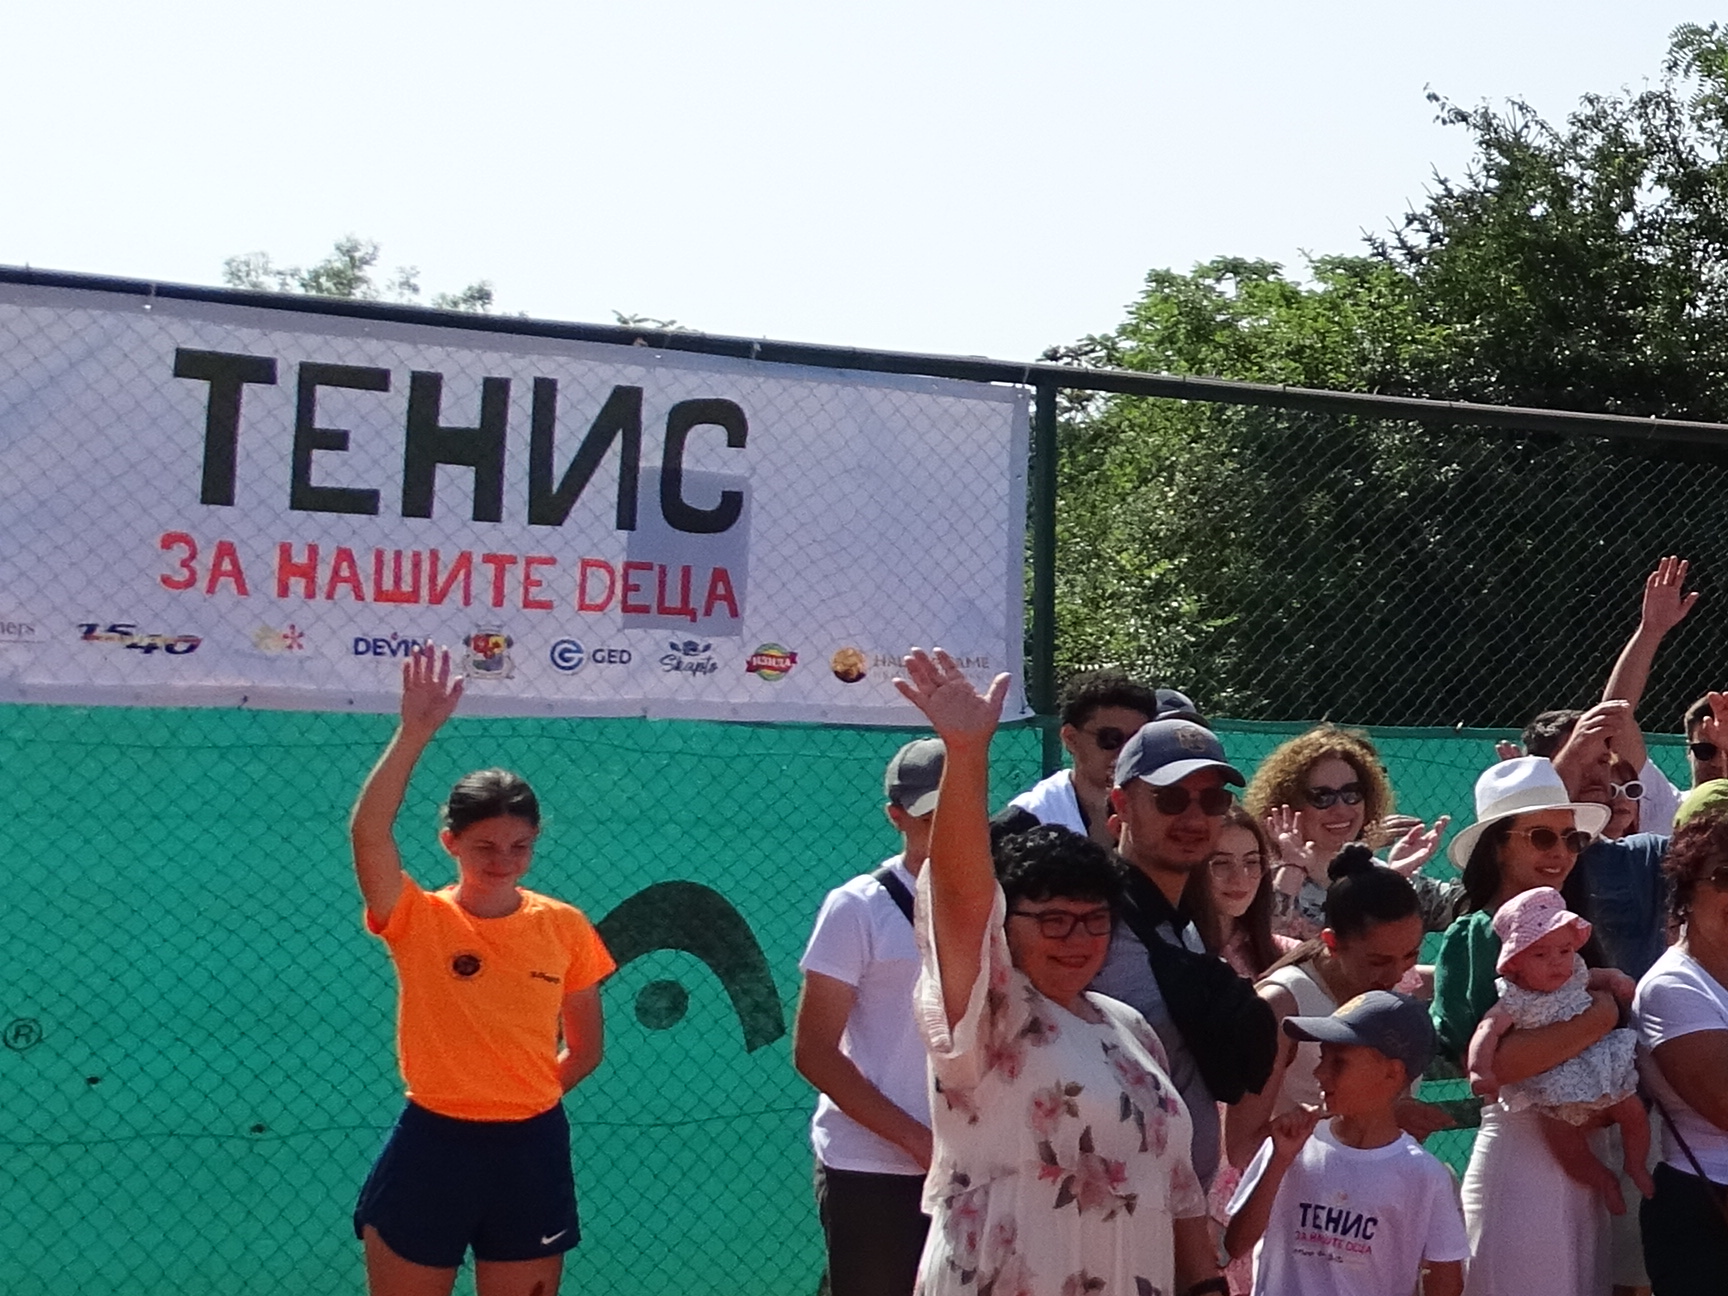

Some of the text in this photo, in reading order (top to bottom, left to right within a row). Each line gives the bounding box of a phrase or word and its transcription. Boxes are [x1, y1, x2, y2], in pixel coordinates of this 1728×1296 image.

[173, 346, 749, 535] ТЕНИС
[160, 531, 250, 597] ЗА
[276, 540, 557, 609] НАШИТЕ
[592, 648, 632, 665] GED
[1299, 1202, 1379, 1241] ТЕНИС
